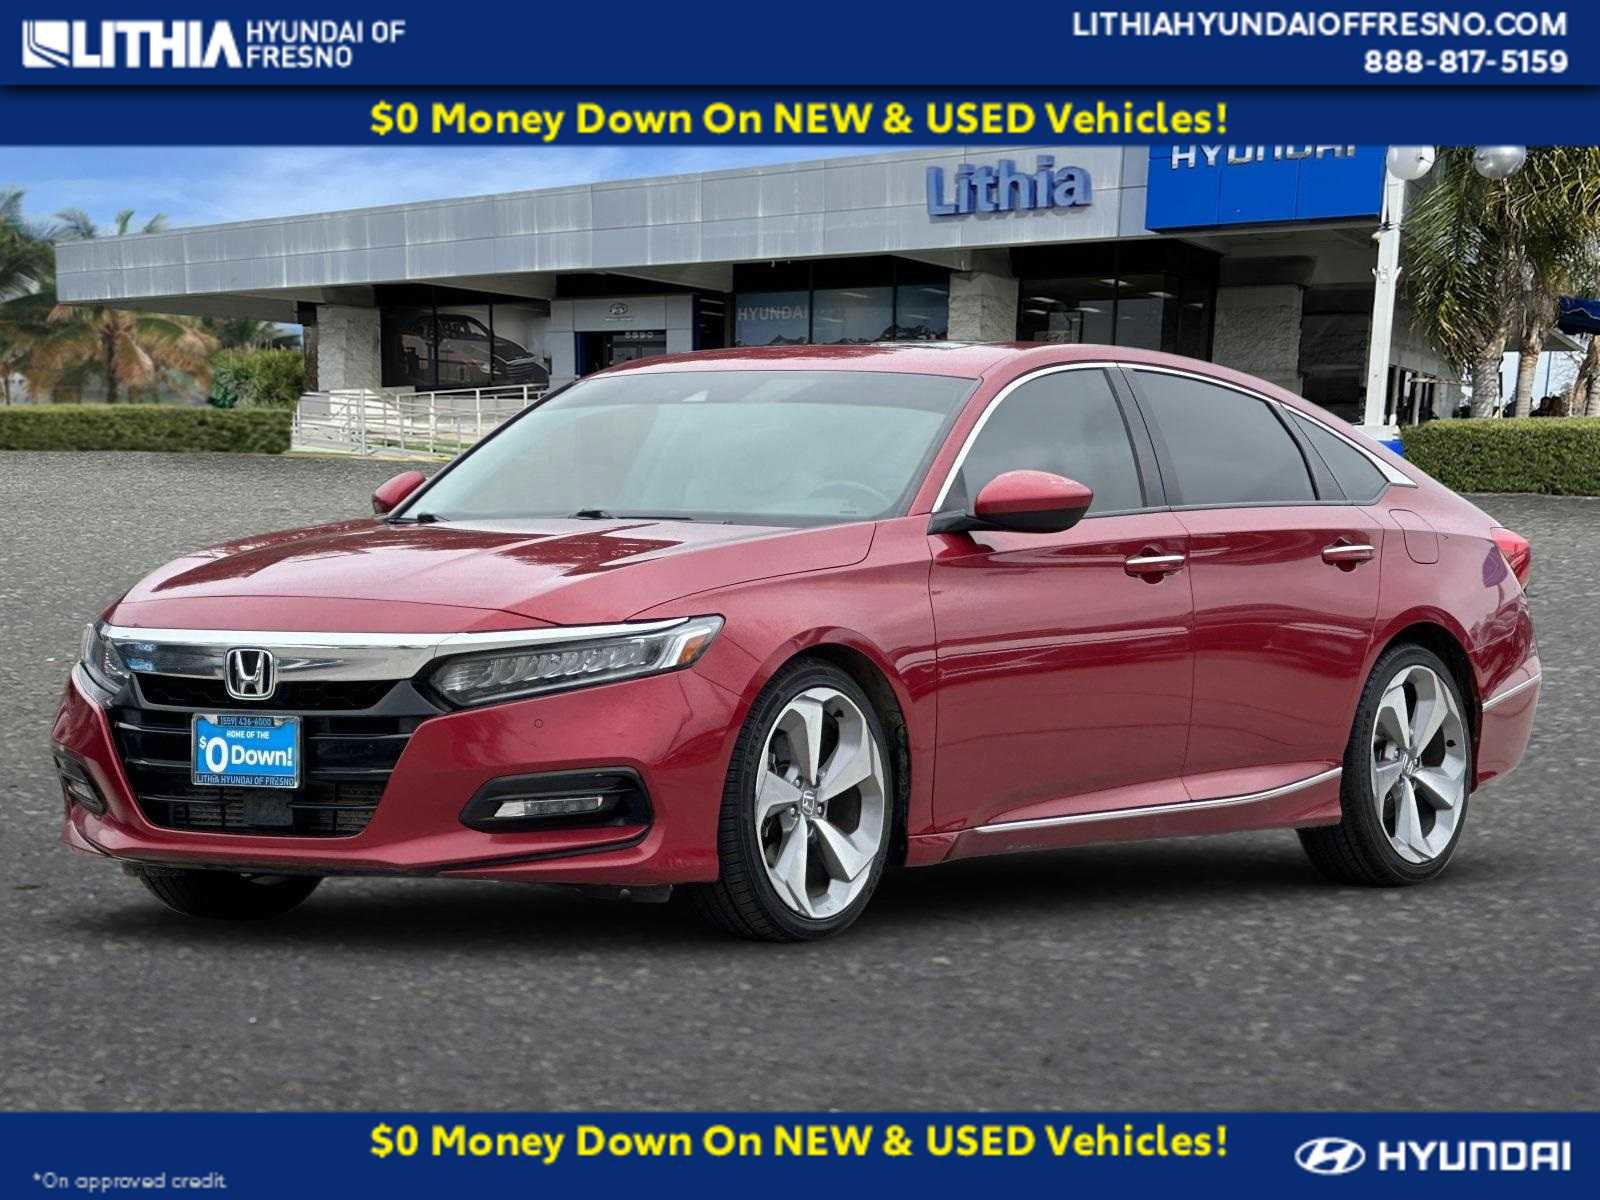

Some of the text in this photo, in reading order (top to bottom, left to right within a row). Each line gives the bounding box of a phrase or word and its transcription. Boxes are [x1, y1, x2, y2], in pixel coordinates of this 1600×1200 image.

[926, 154, 1092, 216] Lithia
[737, 305, 809, 321] HYUNDAI
[226, 730, 270, 740] HOME OF THE
[231, 745, 294, 767] Down!
[220, 774, 253, 786] HYUNDAI
[254, 776, 265, 786] OF
